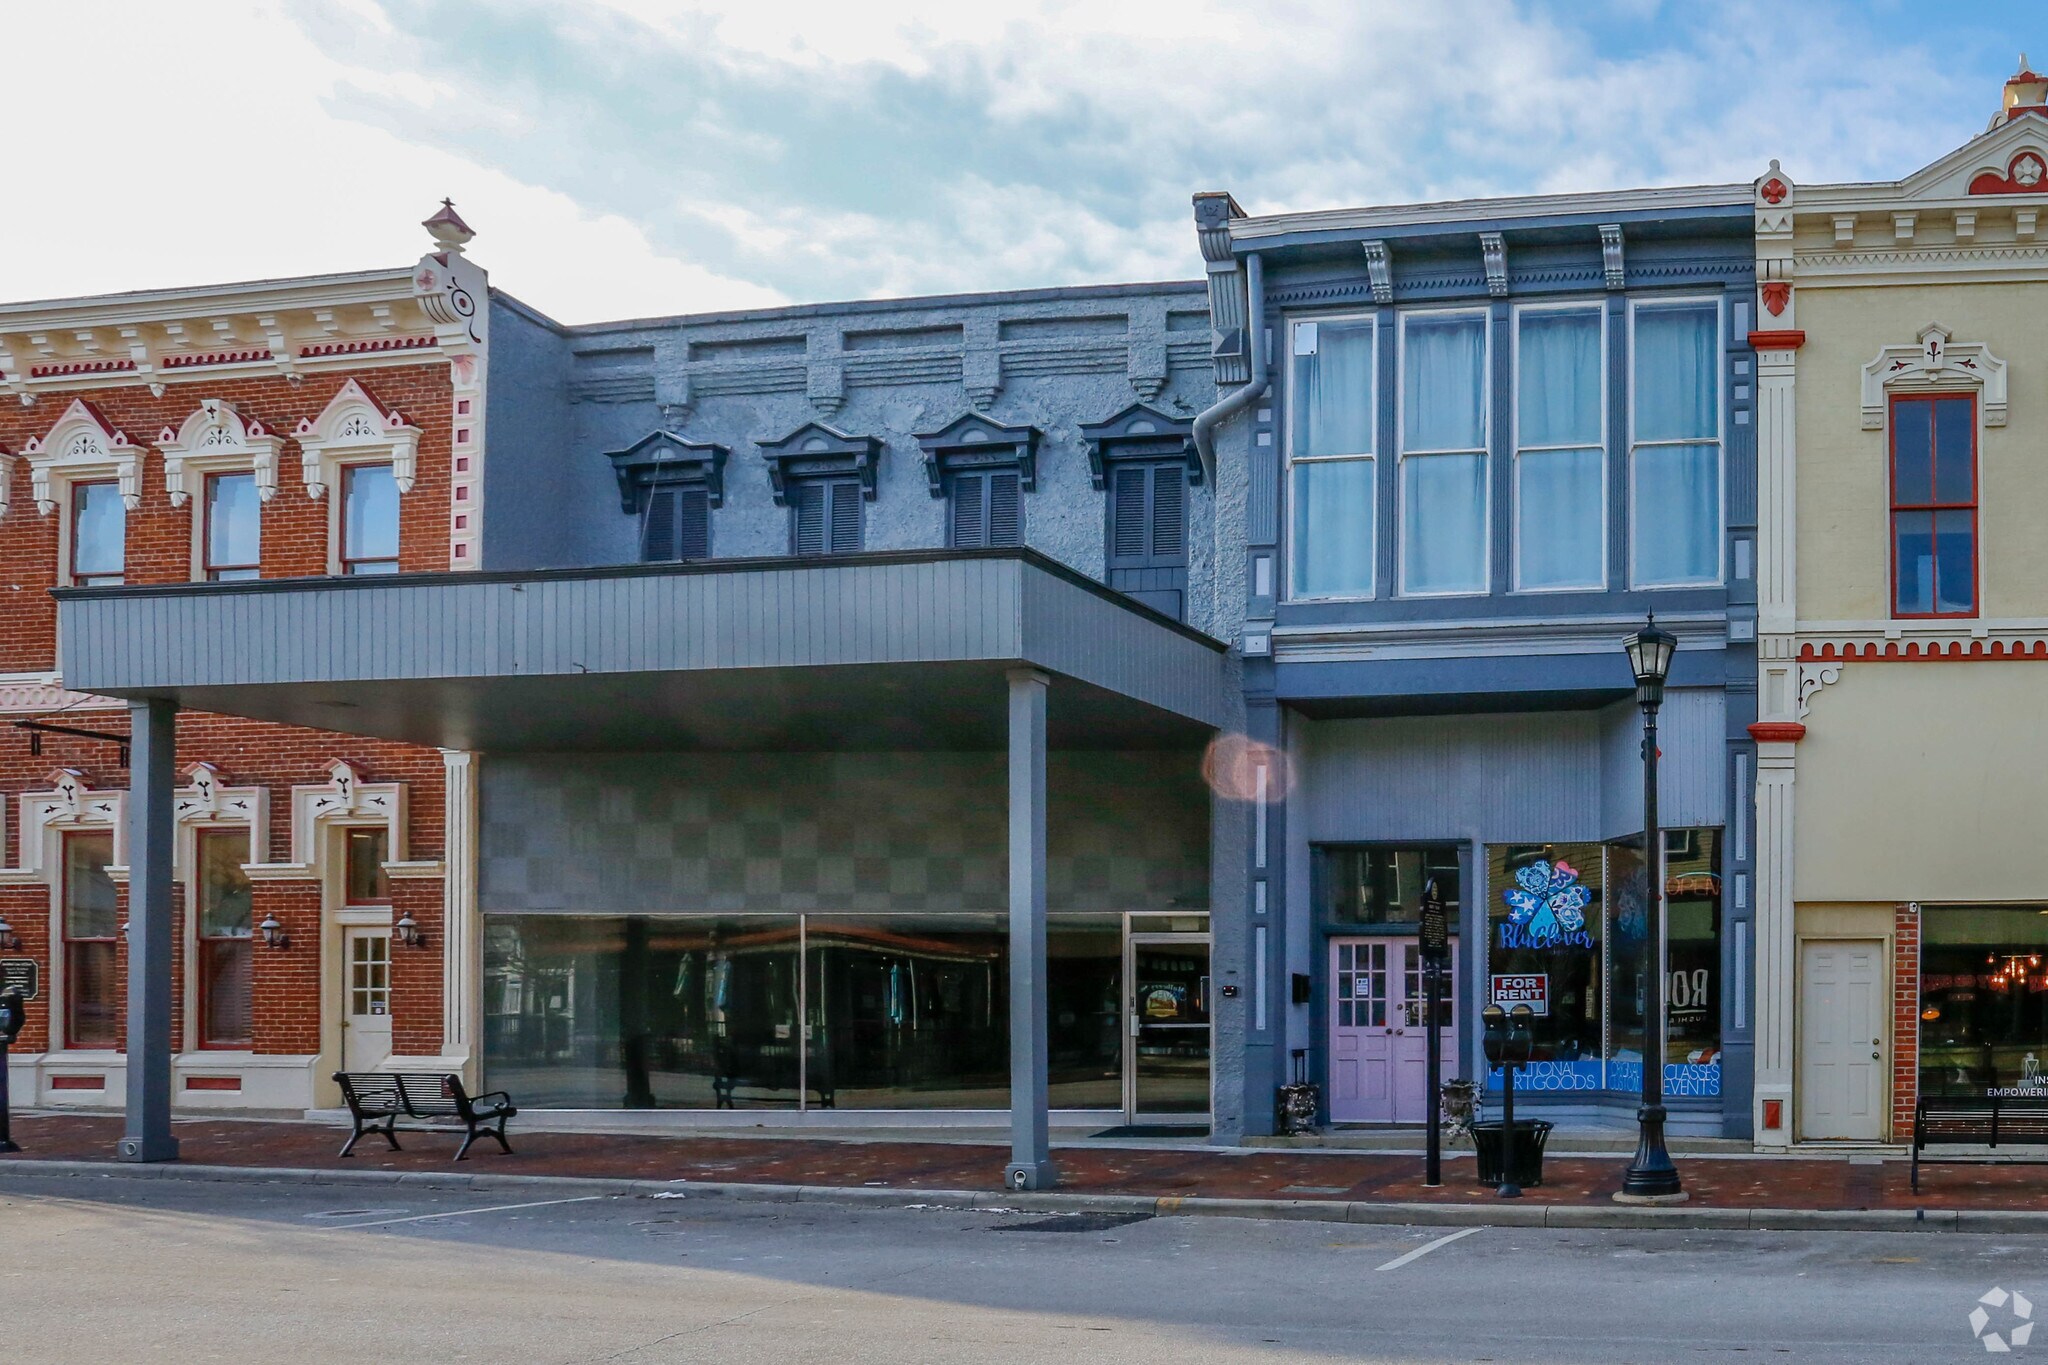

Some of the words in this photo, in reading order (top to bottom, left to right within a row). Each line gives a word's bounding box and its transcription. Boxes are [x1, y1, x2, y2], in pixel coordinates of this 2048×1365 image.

[1666, 878, 1720, 896] OPEN
[1502, 978, 1537, 989] FOR
[1497, 989, 1543, 1000] RENT
[1663, 1063, 1721, 1080] CLASSES
[1663, 1079, 1720, 1096] EVENTS
[1987, 1087, 2048, 1097] EMPOWERI
